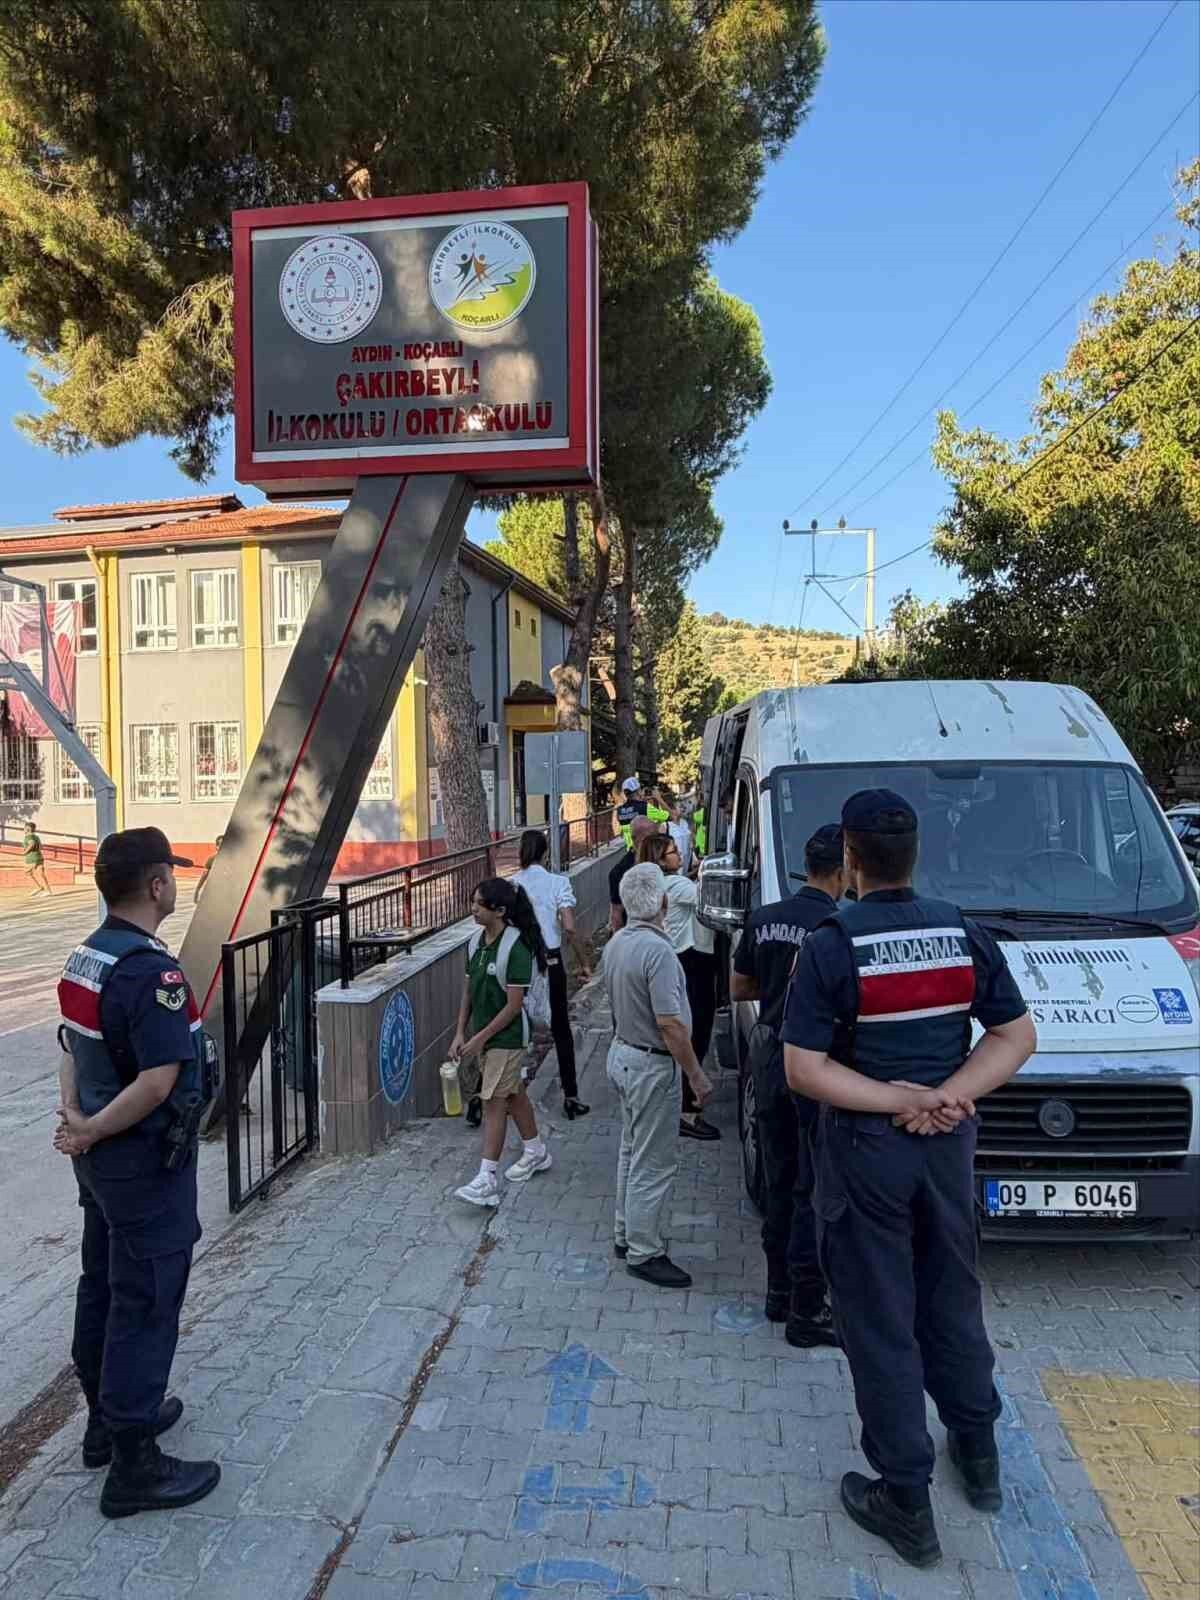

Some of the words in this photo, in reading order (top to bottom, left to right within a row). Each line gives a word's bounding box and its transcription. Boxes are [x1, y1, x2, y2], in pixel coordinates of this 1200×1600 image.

[352, 344, 393, 363] AYDIN
[869, 937, 963, 965] JANDARMA
[1051, 1008, 1116, 1024] ARACI
[1000, 1184, 1027, 1206] 09
[1043, 1184, 1057, 1207] P
[1075, 1185, 1133, 1208] 6046
